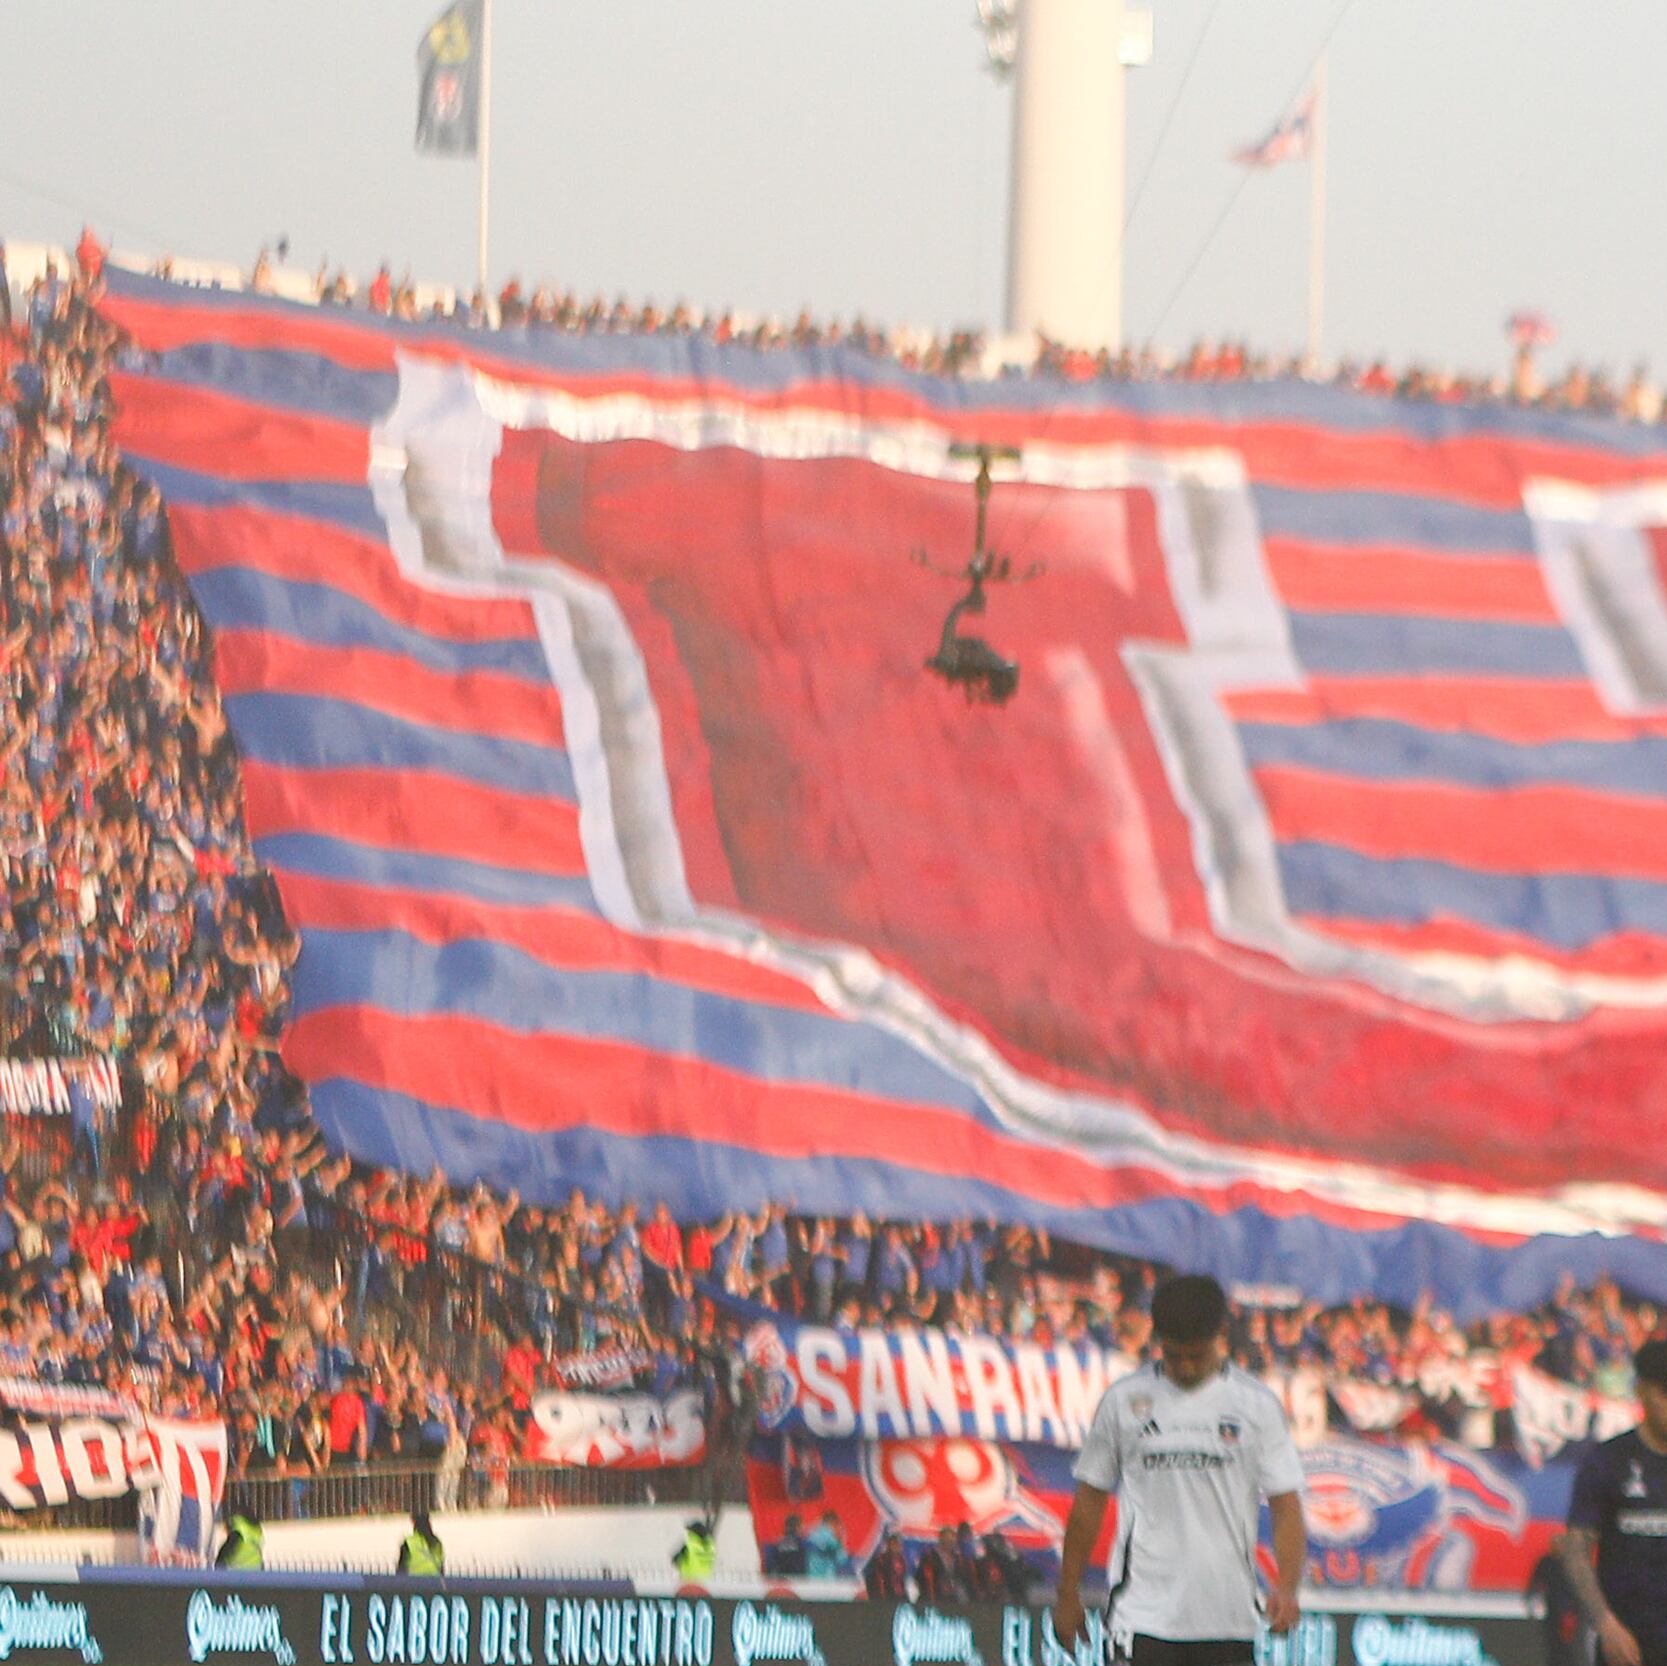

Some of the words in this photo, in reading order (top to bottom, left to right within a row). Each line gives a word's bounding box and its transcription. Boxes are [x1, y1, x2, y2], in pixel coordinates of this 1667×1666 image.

[795, 1324, 961, 1440] SAN
[320, 1593, 354, 1664] EL
[367, 1593, 470, 1665] SABOR
[480, 1595, 533, 1666] DEL
